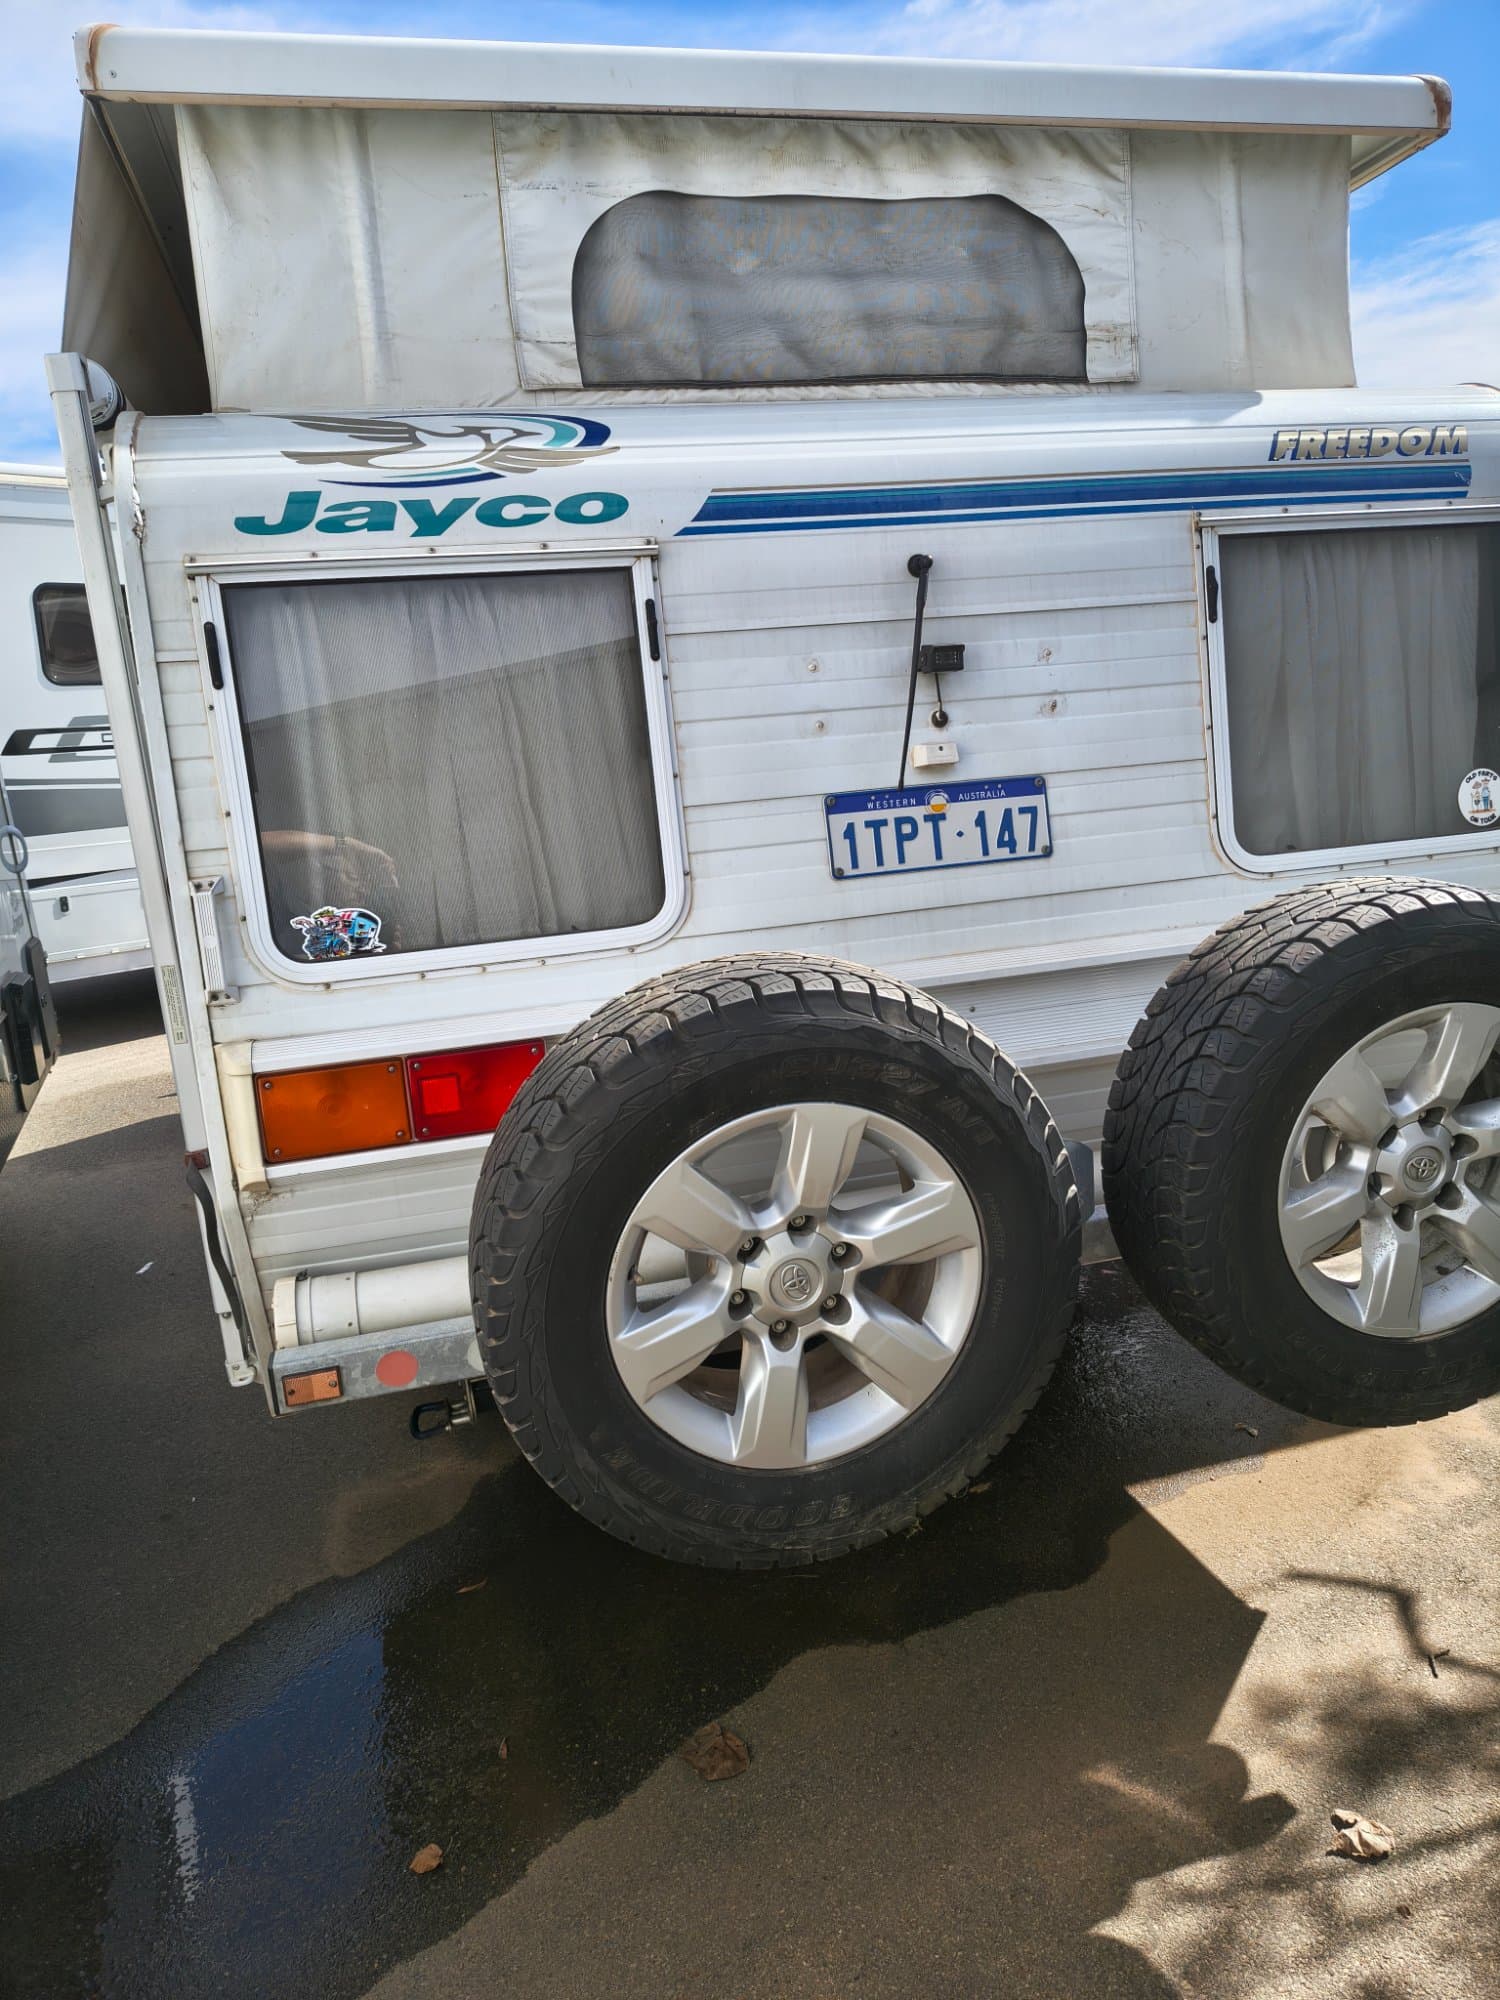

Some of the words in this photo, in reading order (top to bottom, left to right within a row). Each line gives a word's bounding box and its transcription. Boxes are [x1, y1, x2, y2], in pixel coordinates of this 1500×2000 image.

[1268, 425, 1469, 461] FREEDOM
[234, 490, 629, 537] Jayco
[1465, 772, 1477, 783] OLD
[866, 797, 917, 809] WESTERN
[957, 789, 1007, 801] AUSTRALIA
